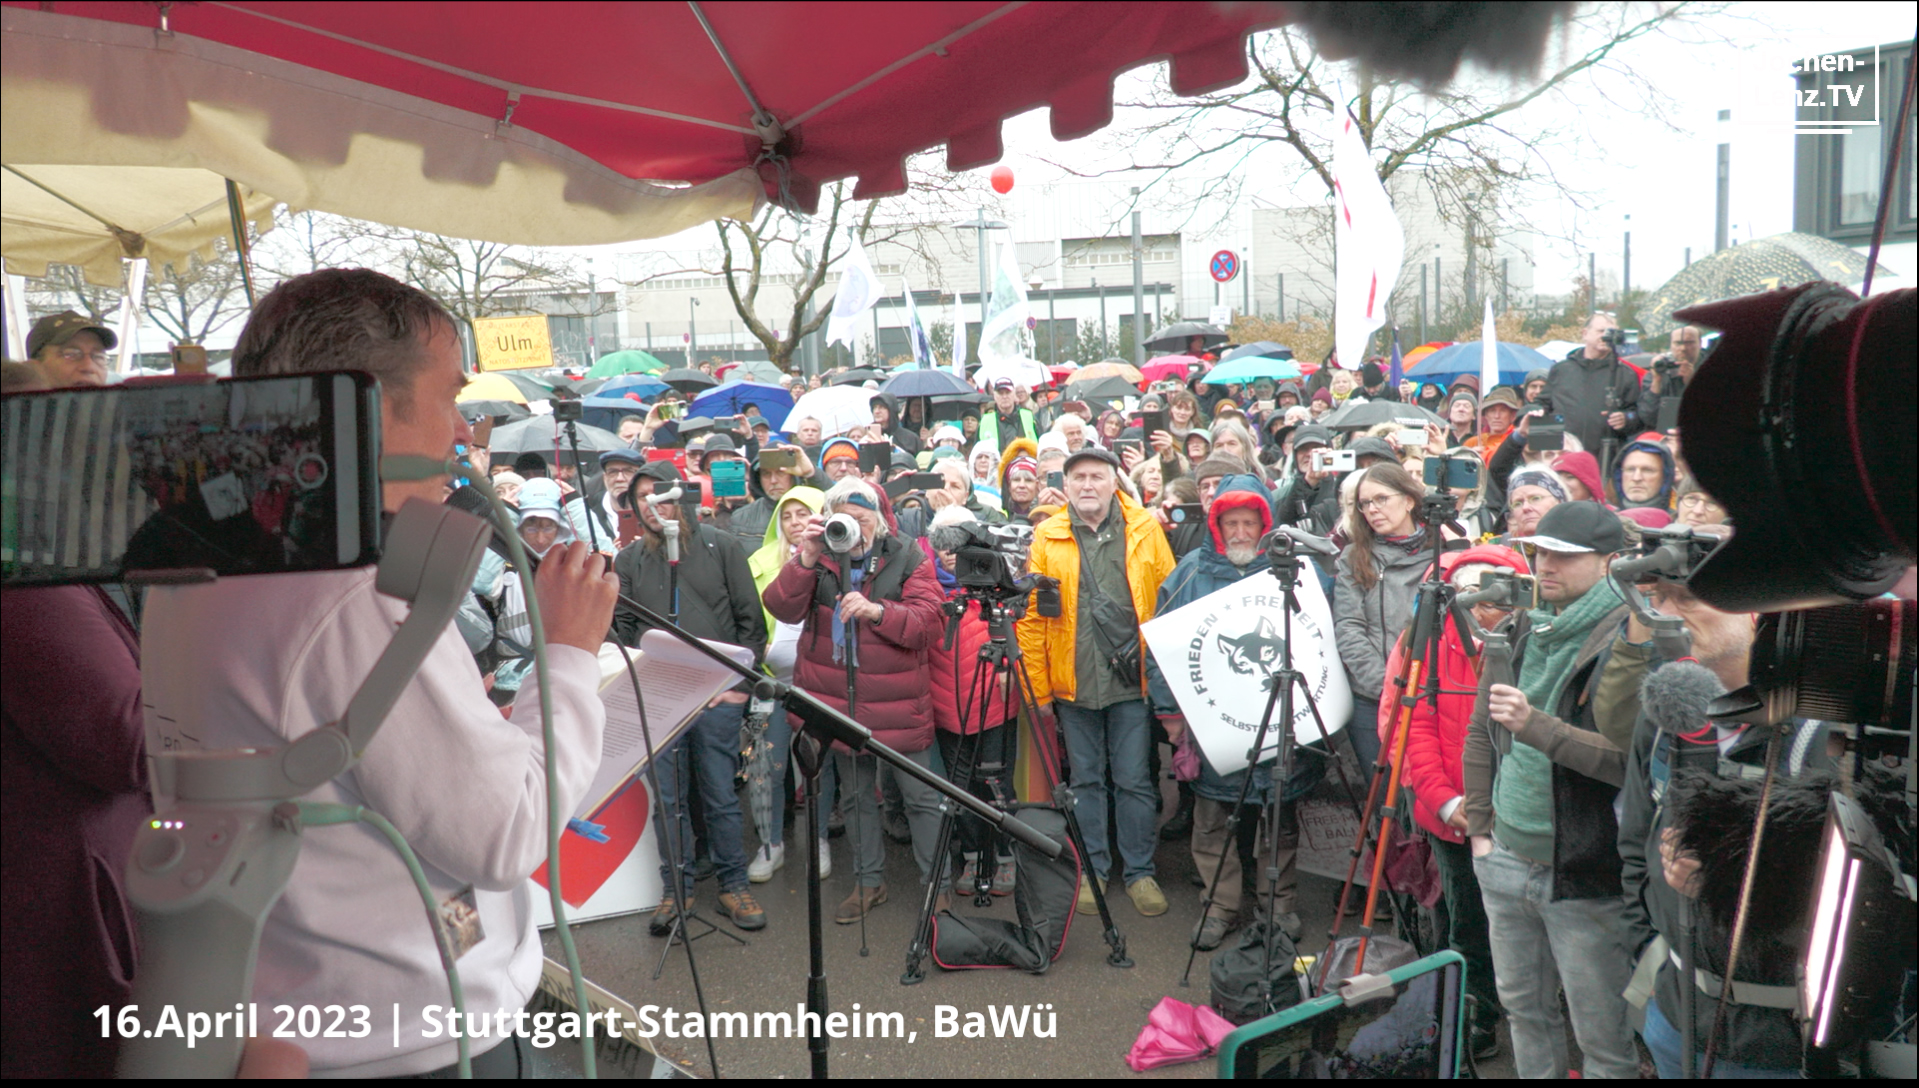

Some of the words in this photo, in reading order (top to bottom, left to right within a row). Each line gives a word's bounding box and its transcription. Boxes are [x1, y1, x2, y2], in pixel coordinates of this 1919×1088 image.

[497, 334, 533, 352] Ulm
[1241, 594, 1324, 640] FREEIT
[1187, 612, 1219, 696] FRIEDEN
[1305, 814, 1340, 828] FREE
